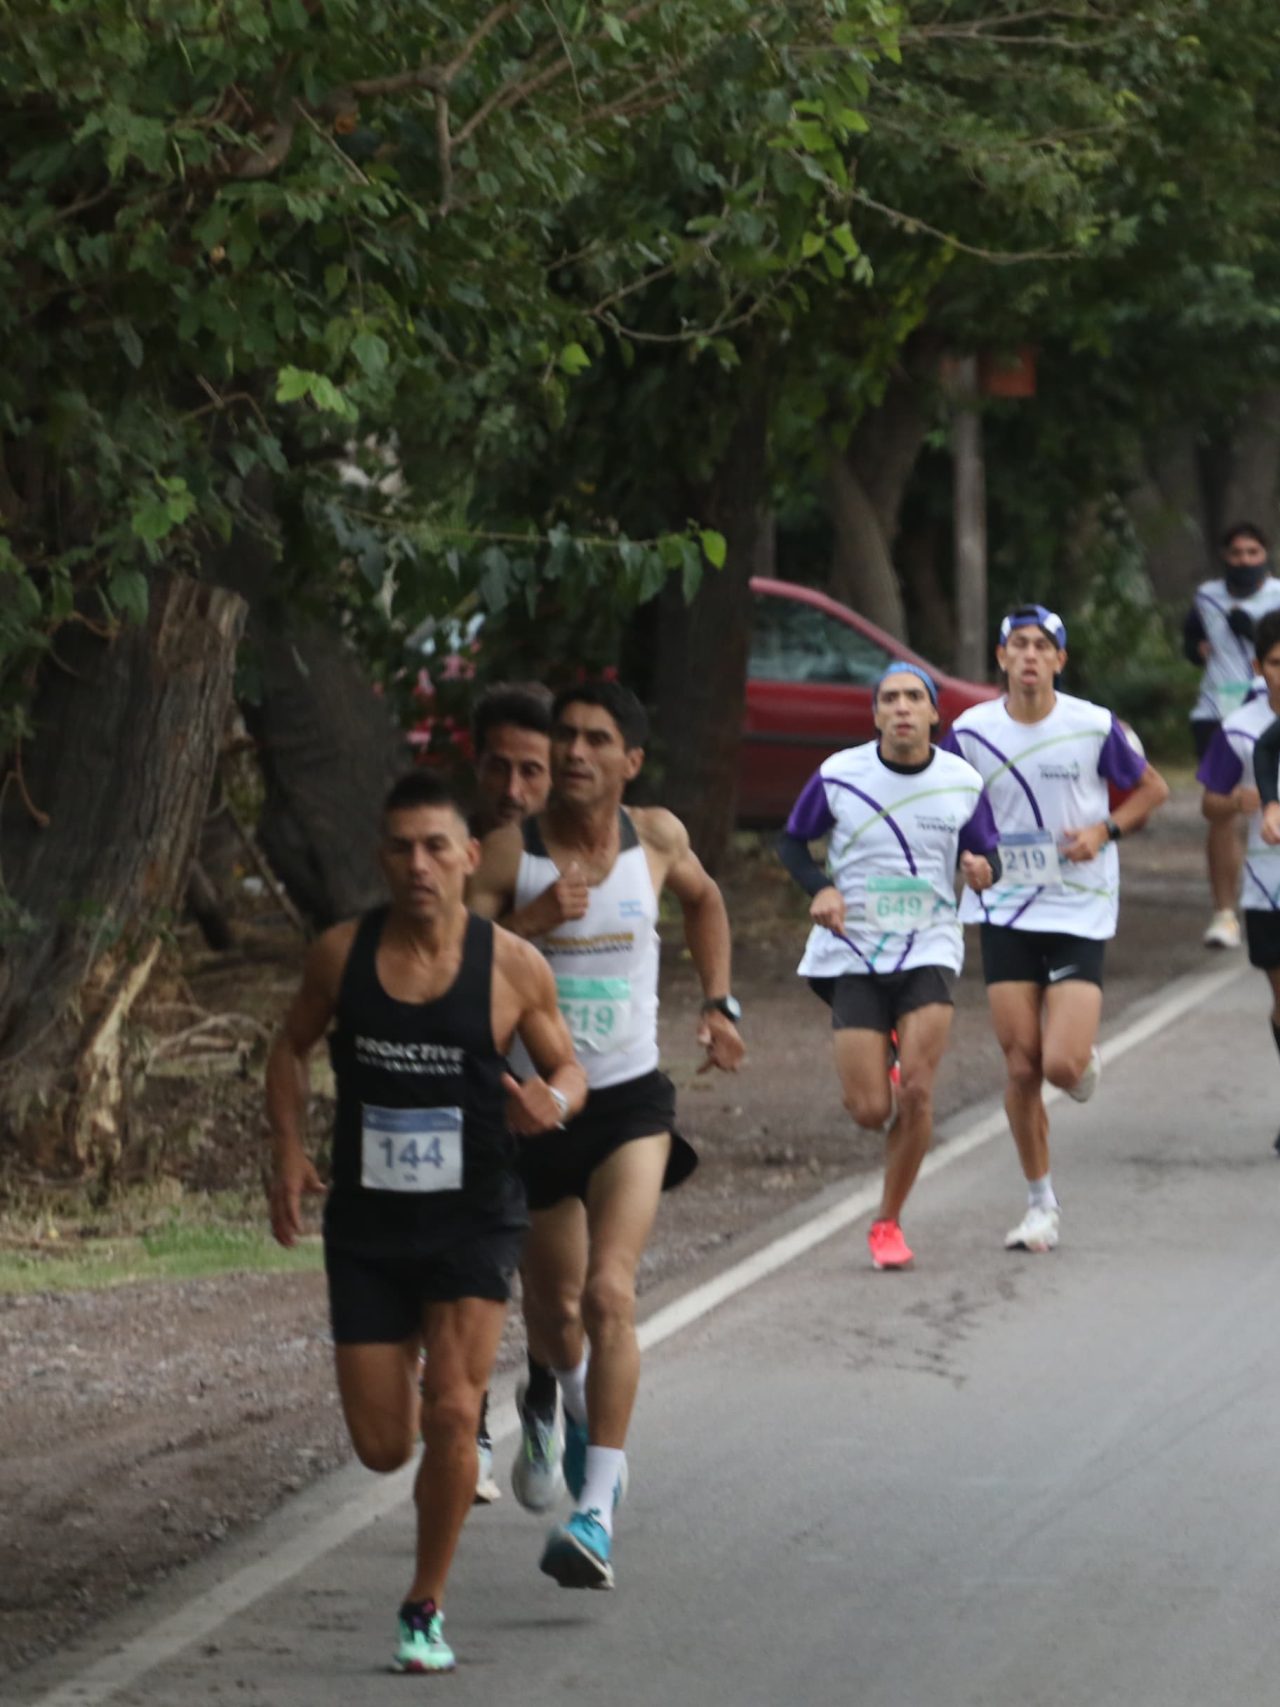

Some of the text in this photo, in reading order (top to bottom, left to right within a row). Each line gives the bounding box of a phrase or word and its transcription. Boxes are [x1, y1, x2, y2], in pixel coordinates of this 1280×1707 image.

[1004, 848, 1046, 870] 219
[876, 896, 922, 917] 649
[355, 1034, 464, 1062] PROACTIVE
[379, 1136, 444, 1170] 144
